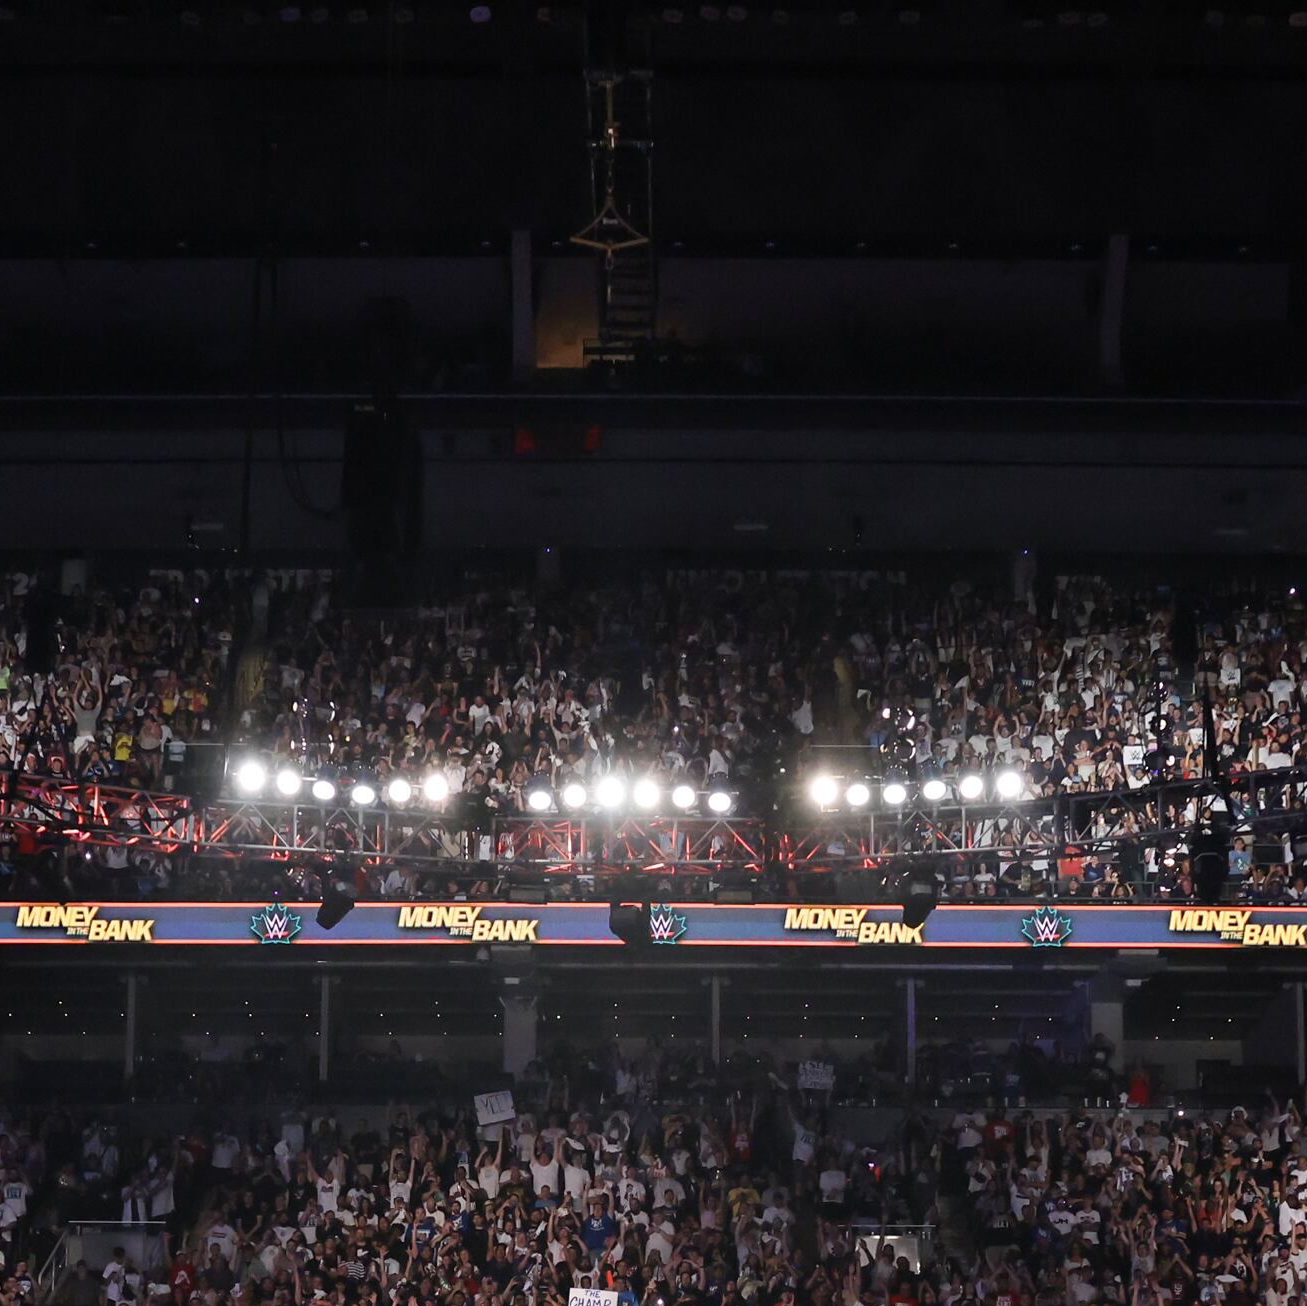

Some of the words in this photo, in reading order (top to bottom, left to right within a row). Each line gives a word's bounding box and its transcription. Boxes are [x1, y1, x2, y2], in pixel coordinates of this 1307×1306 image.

[16, 906, 98, 927] MONEY
[88, 920, 155, 940] BANK
[398, 906, 482, 927] MONEY
[472, 919, 538, 941] BANK
[785, 909, 867, 929] MONEY
[858, 923, 925, 943] BANK
[1170, 910, 1253, 931] MONEY
[1243, 925, 1307, 945] BANK
[585, 1290, 601, 1298] THE
